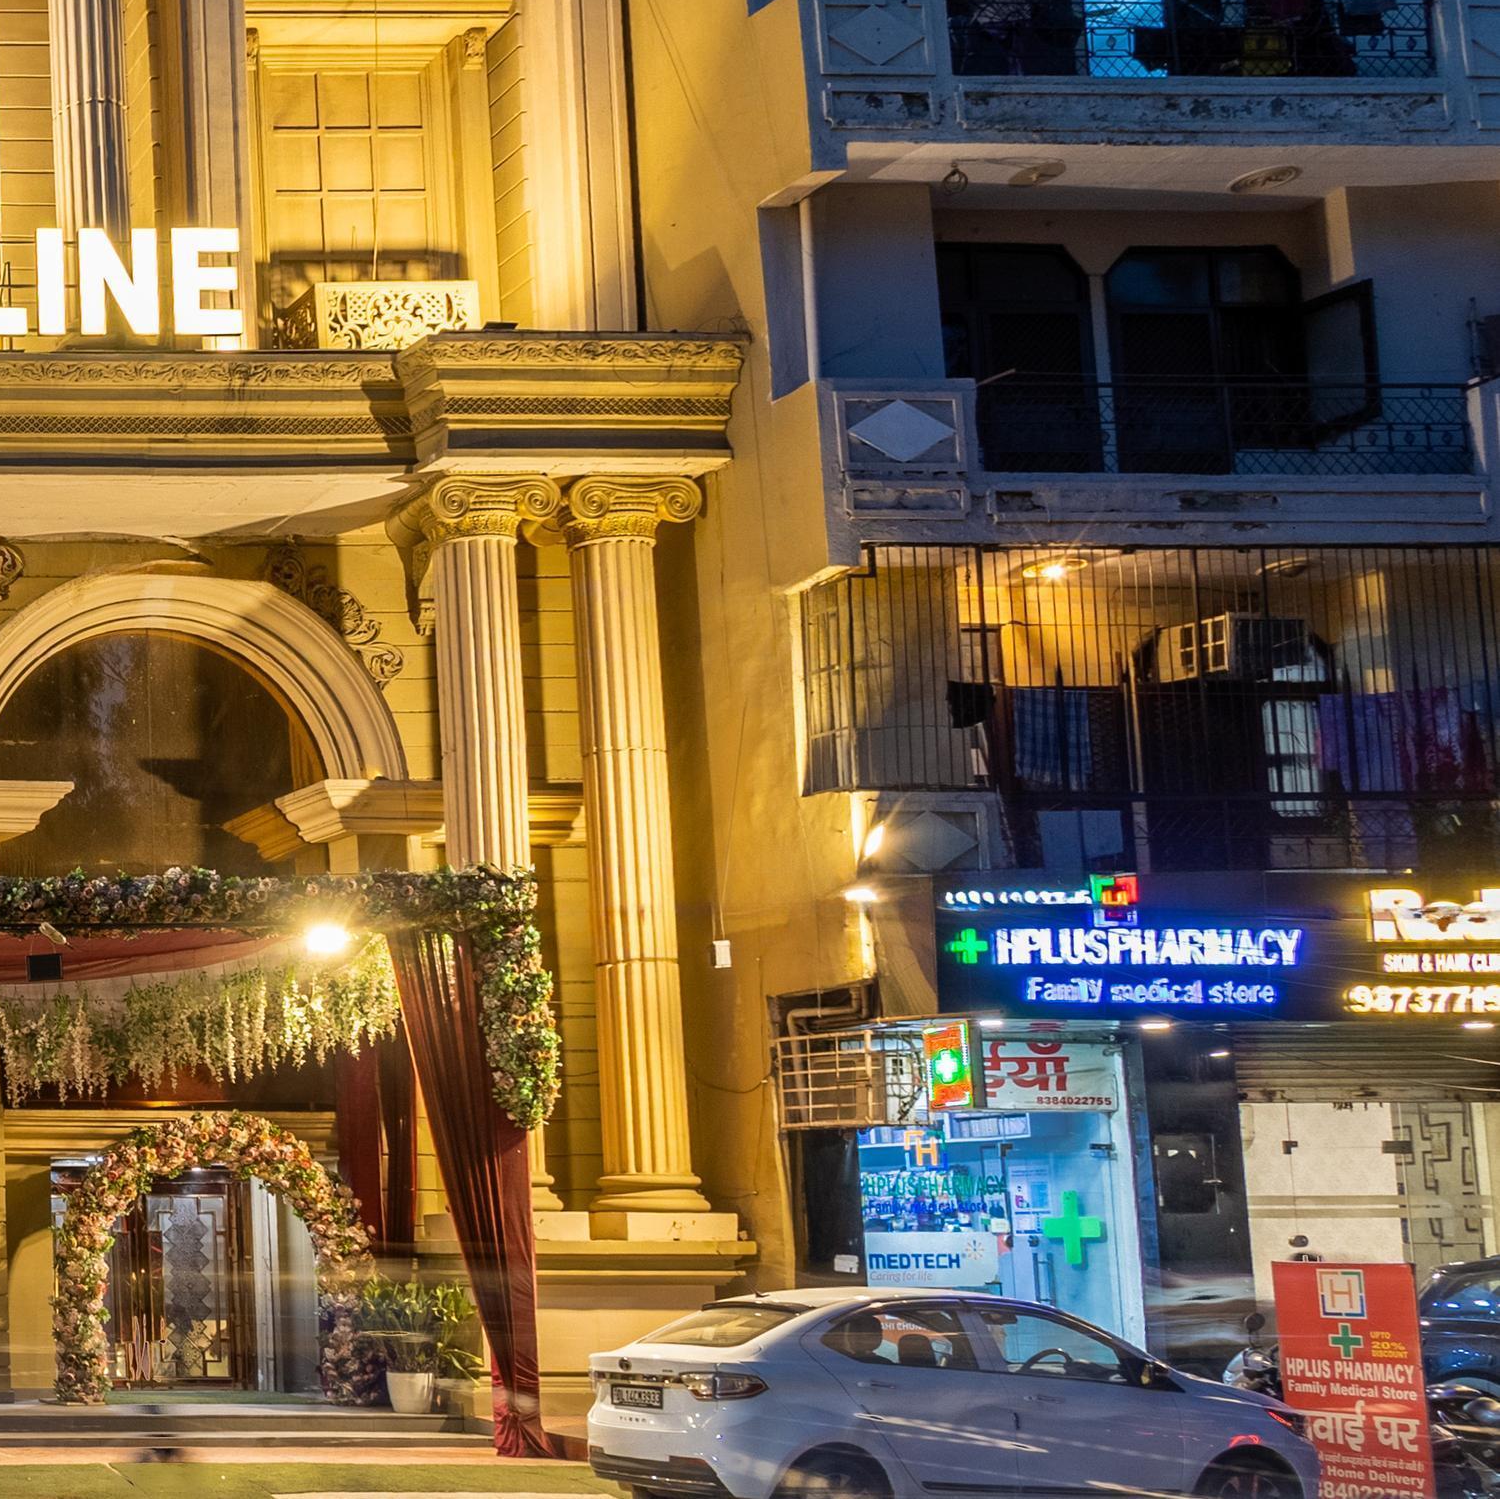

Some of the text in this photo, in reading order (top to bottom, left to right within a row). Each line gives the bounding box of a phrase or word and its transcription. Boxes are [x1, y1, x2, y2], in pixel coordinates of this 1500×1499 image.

[1208, 980, 1276, 1004] store
[869, 1253, 961, 1270] MEDTECH
[870, 1271, 934, 1283] Caring for life
[1370, 1331, 1392, 1340] UPTO
[1371, 1341, 1406, 1351] 20%
[1372, 1350, 1409, 1359] DISCOUNT
[1286, 1358, 1415, 1384] HPLUS PHARMACY
[1287, 1379, 1418, 1401] Family Medical Store
[1305, 1400, 1421, 1453] वाई घर
[1327, 1465, 1426, 1490] Home Delivery
